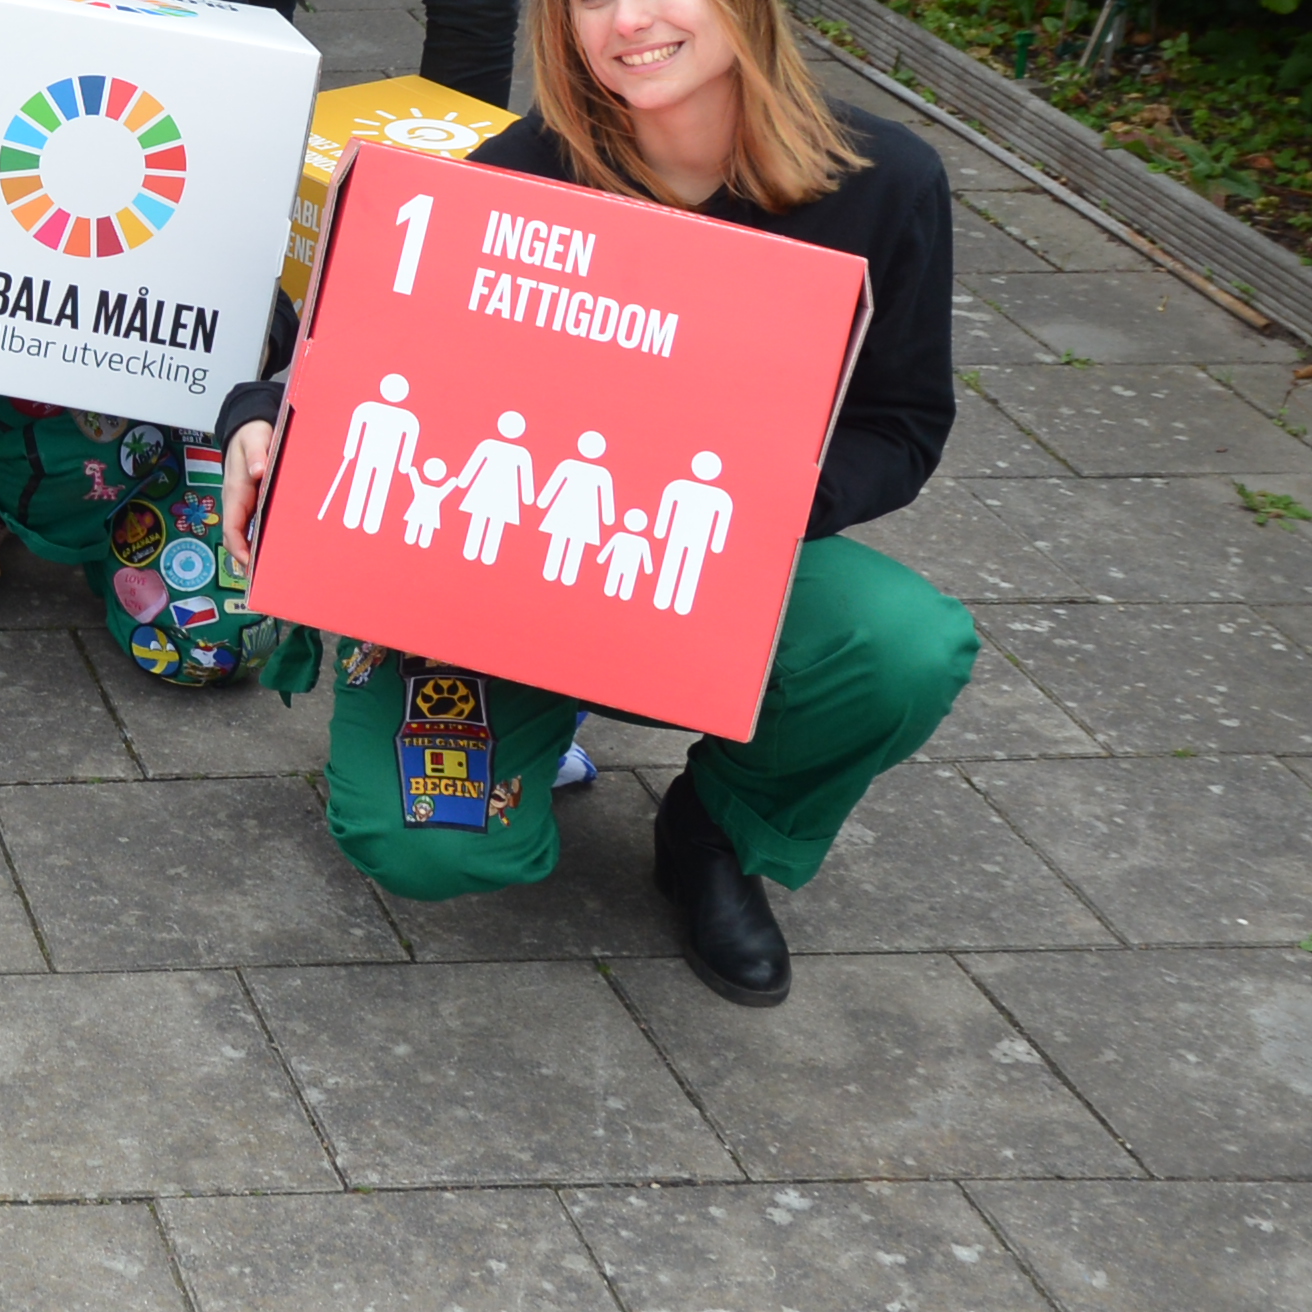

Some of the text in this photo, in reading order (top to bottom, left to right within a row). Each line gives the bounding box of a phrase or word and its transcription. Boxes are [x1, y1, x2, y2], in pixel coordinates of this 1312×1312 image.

[392, 192, 597, 296] 1 INGEN
[91, 285, 220, 354] MÅLEN
[467, 266, 680, 358] FATTIGDOM
[61, 336, 210, 395] utveckling
[124, 573, 148, 586] LOVE
[409, 777, 485, 799] BEGIN!
